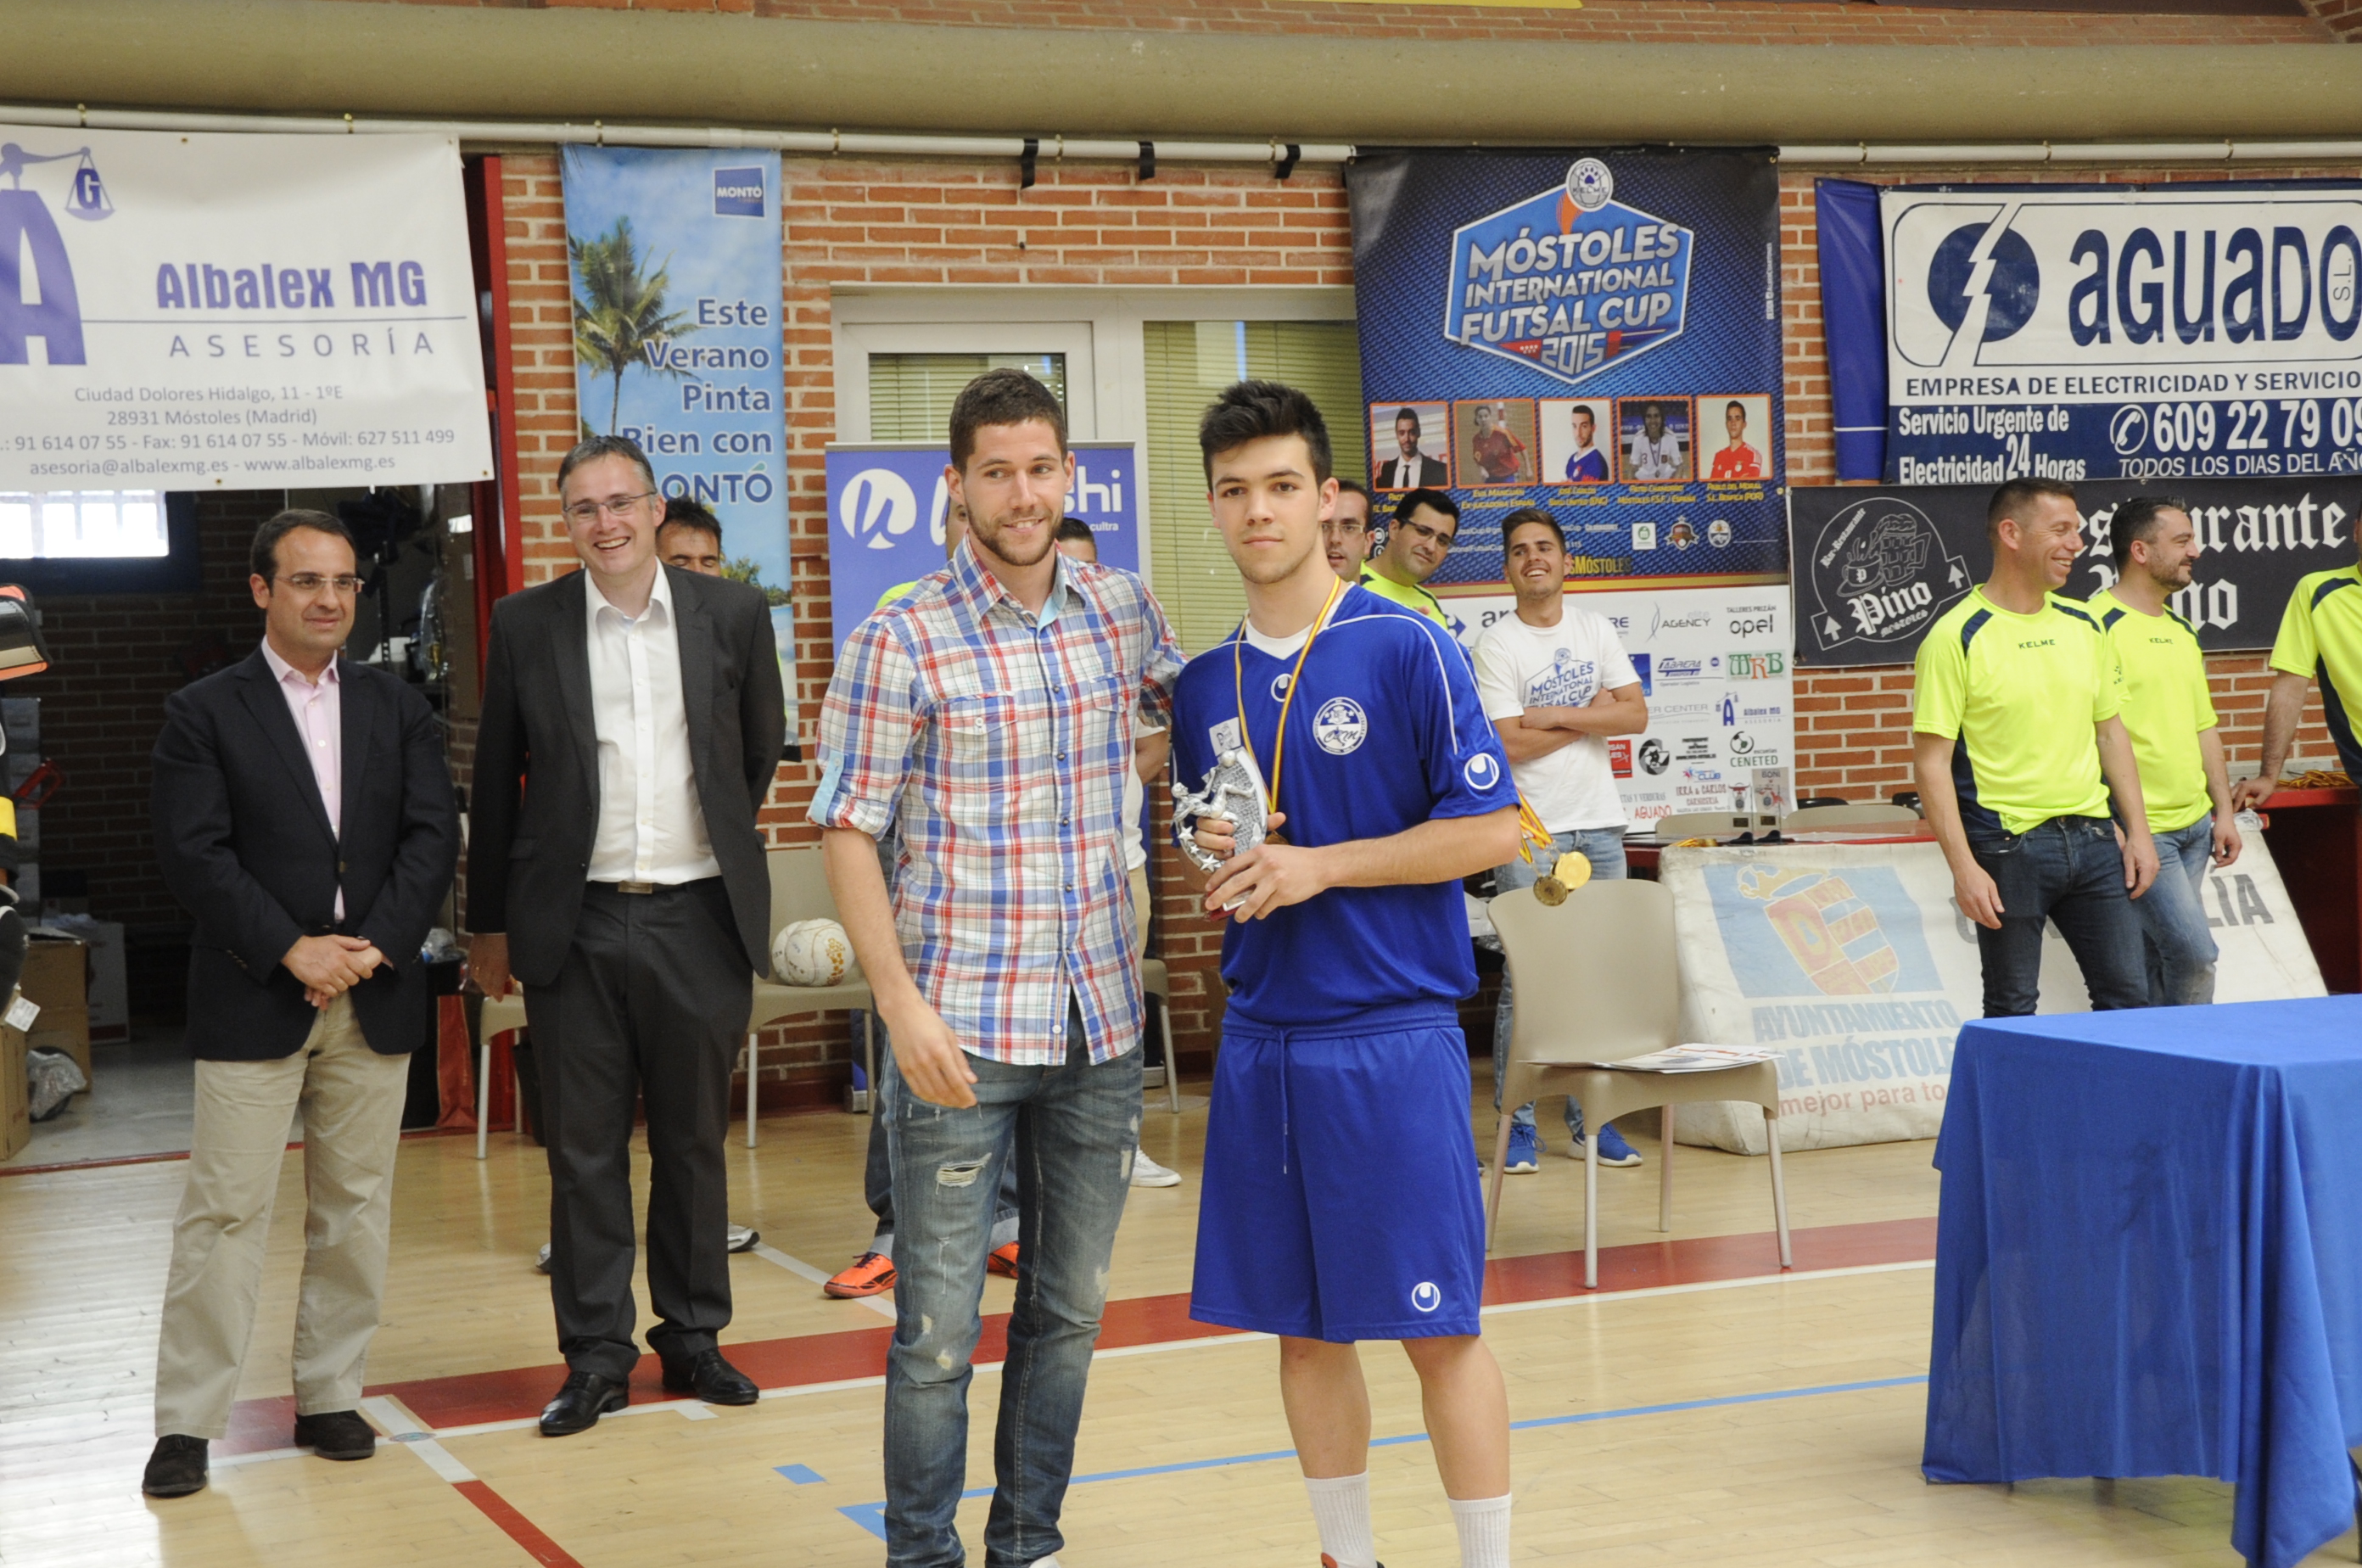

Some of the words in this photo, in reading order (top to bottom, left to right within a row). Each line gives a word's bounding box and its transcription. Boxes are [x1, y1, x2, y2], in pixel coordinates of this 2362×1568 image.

[76, 168, 103, 210] G
[1468, 222, 1680, 283] MÓSTOLES
[157, 262, 336, 308] Albalex
[350, 260, 428, 307] MG
[1465, 262, 1674, 308] INTERNATIONAL
[698, 299, 770, 328] Este
[1460, 300, 1592, 345] FUTSAL
[1598, 293, 1672, 328] CUP
[170, 331, 435, 357] ASESORÍA
[646, 341, 771, 370] Verano
[1541, 332, 1608, 375] 2015
[75, 386, 134, 403] Ciudad
[140, 386, 204, 402] Dolores
[209, 385, 277, 404] Hidalgo,
[282, 387, 299, 400] 11
[683, 384, 772, 412] Pinta
[1906, 376, 2022, 398] EMPRESA
[2029, 376, 2059, 397] DE
[2065, 373, 2229, 396] ELECTRICIDAD
[2234, 373, 2248, 391] Y
[2254, 371, 2362, 391] SERVICIO
[108, 411, 159, 426] 28931
[165, 409, 242, 426] Móstoles
[246, 408, 318, 427] (Madrid)
[1899, 406, 1970, 436] Servicio
[1973, 405, 2044, 440] Urgente
[2047, 404, 2070, 433] de
[2153, 400, 2216, 451] 609
[2226, 400, 2269, 450] 22
[2280, 399, 2321, 449] 79
[14, 435, 36, 451] 91
[42, 435, 74, 451] 614
[79, 435, 100, 451] 07
[106, 435, 126, 450] 55
[143, 434, 176, 449] Fax:
[180, 434, 201, 449] 91
[207, 434, 236, 448] 614
[242, 434, 261, 448] 07
[267, 433, 287, 447] 55
[302, 430, 353, 447] Móvil:
[357, 430, 387, 445] 627
[391, 430, 422, 445] 511
[425, 428, 456, 444] 499
[714, 433, 772, 454] con
[1899, 454, 2005, 485] Electricidad
[2006, 433, 2031, 481] 24
[2035, 452, 2086, 481] Horas
[2119, 458, 2186, 478] TODOS
[2191, 456, 2230, 477] LOS
[2236, 454, 2282, 475] DIAS
[2286, 453, 2326, 473] DEL
[2328, 448, 2362, 473] AÑ
[662, 462, 774, 504] ONTÓ
[1661, 618, 1711, 629] AGENCY
[1847, 581, 1934, 636] Pino
[1730, 613, 1773, 639] opel
[2018, 639, 2057, 650] KELME
[1531, 661, 1595, 696] MÓSTOLES
[1731, 754, 1778, 768] CENETED
[1752, 1002, 1962, 1043] AYUNTAMIENTO
[1809, 1035, 1957, 1085] MÓSTOLE
[1778, 1089, 1852, 1117] mejor
[1861, 1083, 1917, 1112] para
